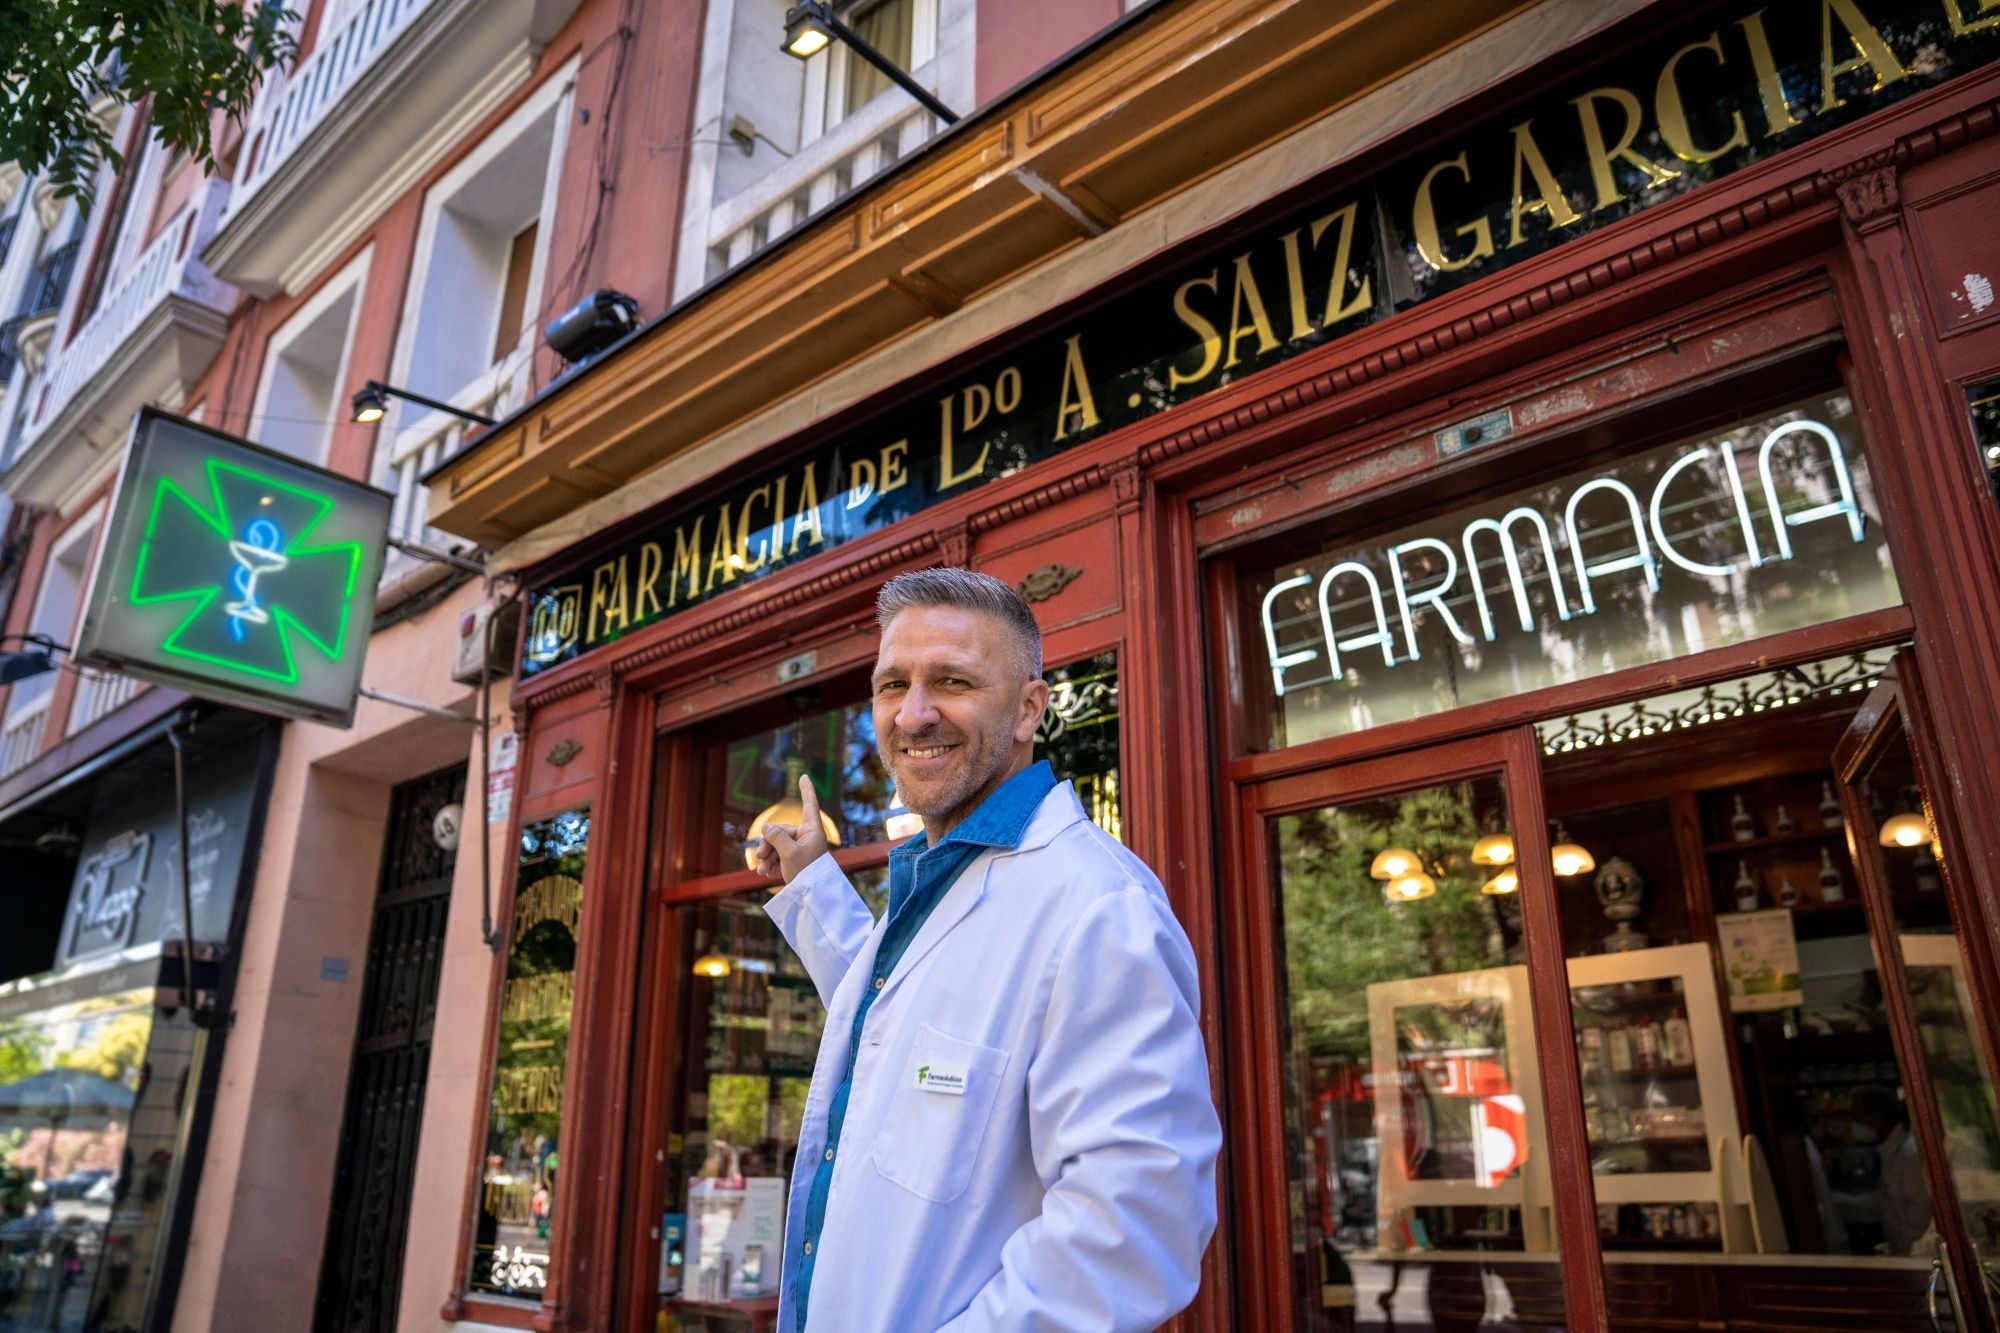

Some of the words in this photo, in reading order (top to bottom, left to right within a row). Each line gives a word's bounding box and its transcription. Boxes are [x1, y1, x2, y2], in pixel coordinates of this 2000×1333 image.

[586, 460, 825, 644] FARMACIA
[845, 438, 910, 511] DE
[1168, 200, 1372, 386] SAIZ
[1411, 0, 1917, 273] GARCIA
[1261, 418, 1866, 696] FARMACIA
